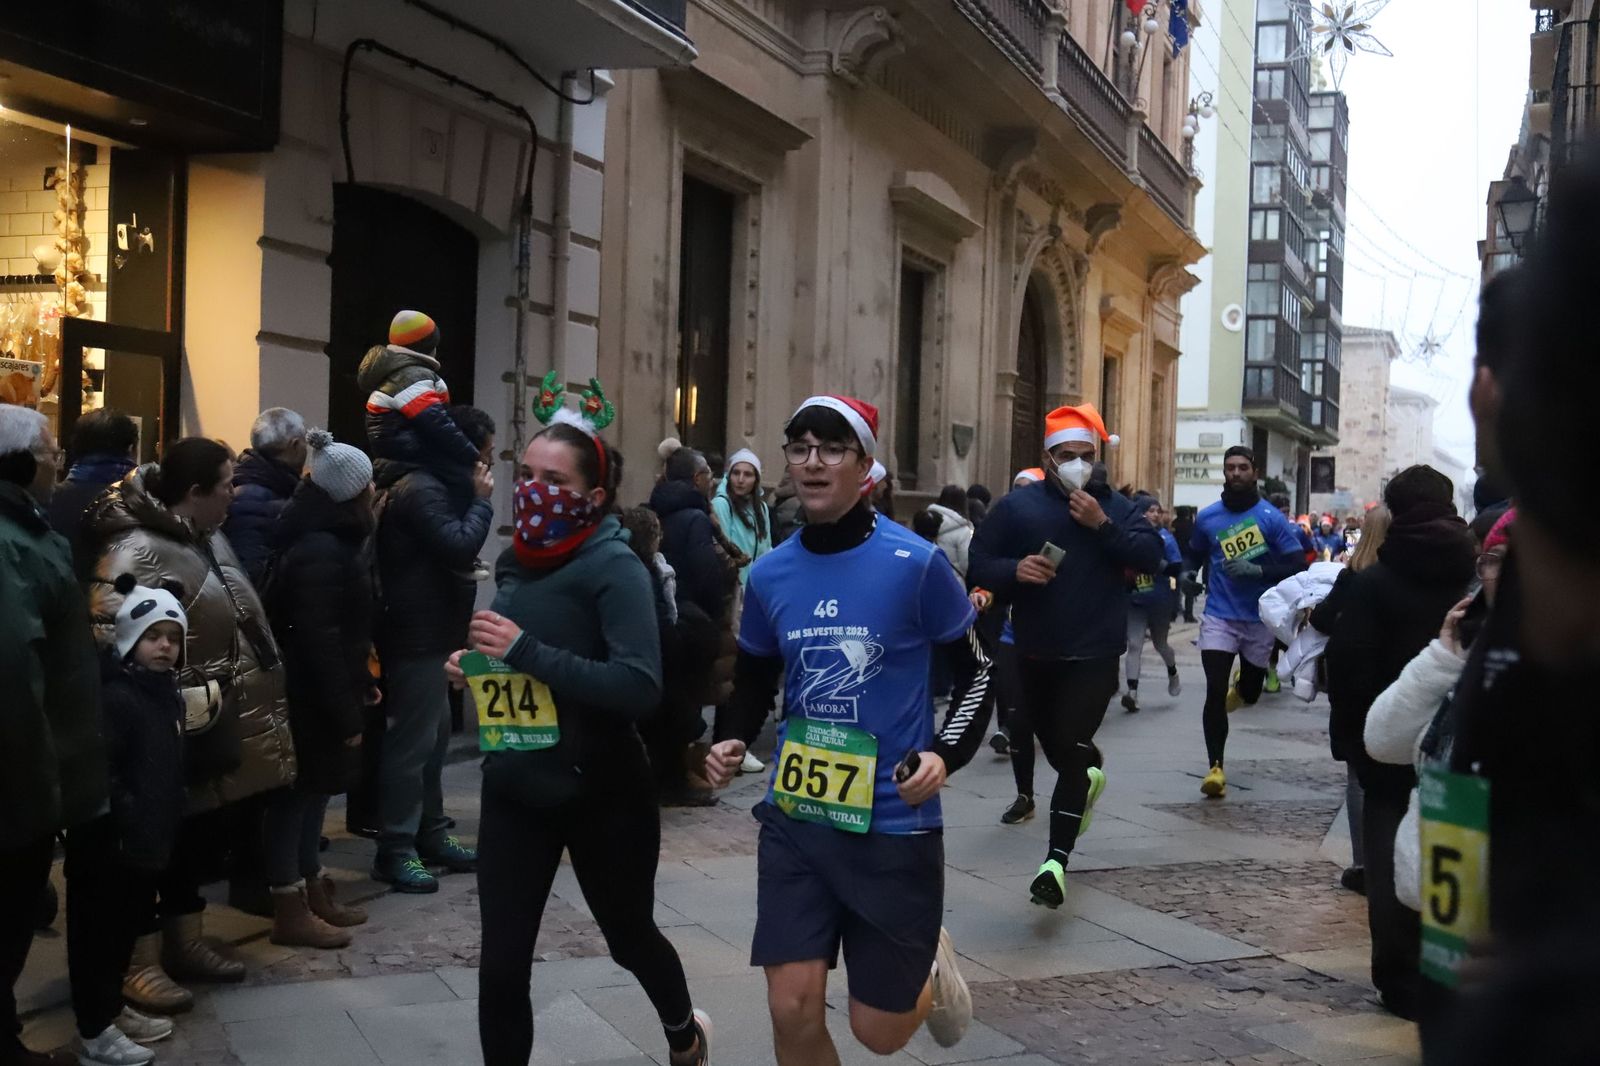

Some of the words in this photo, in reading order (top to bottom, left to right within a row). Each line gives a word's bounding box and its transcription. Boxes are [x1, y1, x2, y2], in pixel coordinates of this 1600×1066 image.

[1225, 532, 1258, 558] 962
[814, 599, 838, 618] 46
[787, 631, 801, 641] SAN
[803, 626, 844, 638] SILVESTRE
[846, 626, 870, 636] 2025
[482, 679, 539, 720] 214
[522, 733, 556, 744] RURAL
[805, 732, 820, 742] CAJA
[822, 735, 847, 747] RURAL
[782, 753, 859, 802] 657
[798, 804, 826, 817] CAJA
[1431, 844, 1462, 926] 5
